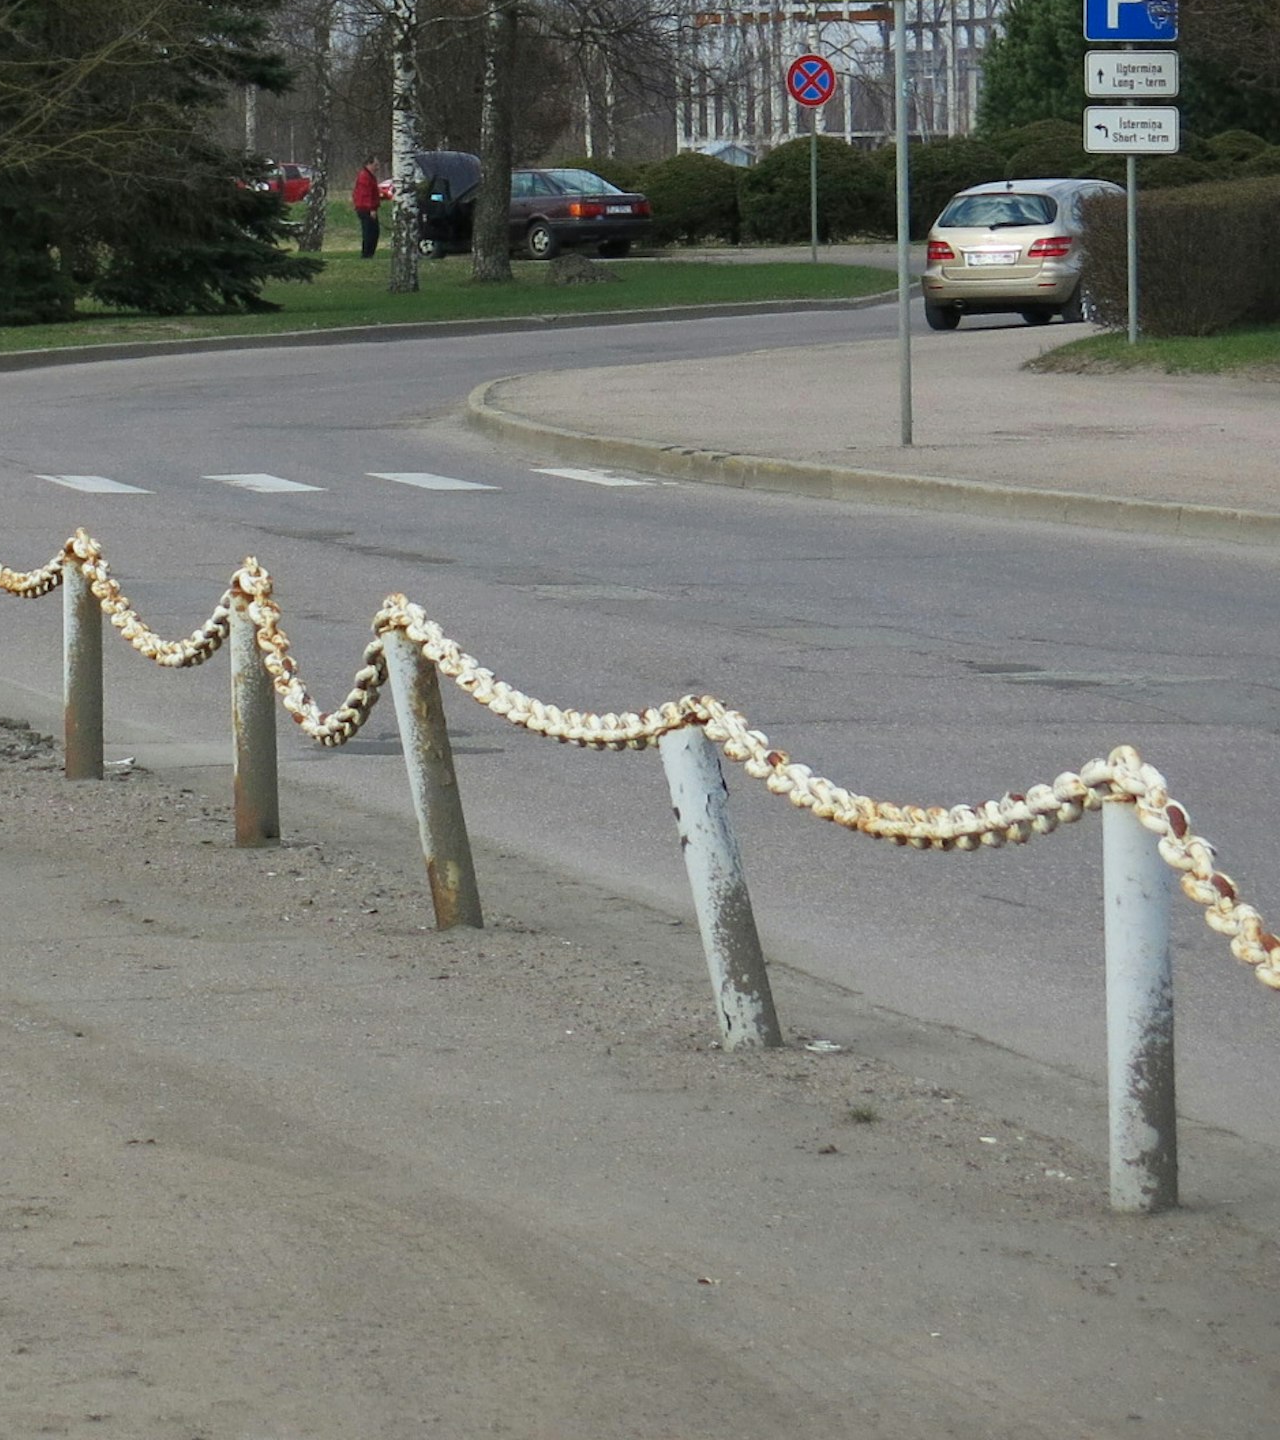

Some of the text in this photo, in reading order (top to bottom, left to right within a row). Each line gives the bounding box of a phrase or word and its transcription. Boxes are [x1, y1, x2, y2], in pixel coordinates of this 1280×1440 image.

[1112, 77, 1135, 90] Long
[1145, 77, 1167, 88] term
[1112, 132, 1138, 143] Short
[1148, 132, 1170, 143] term
